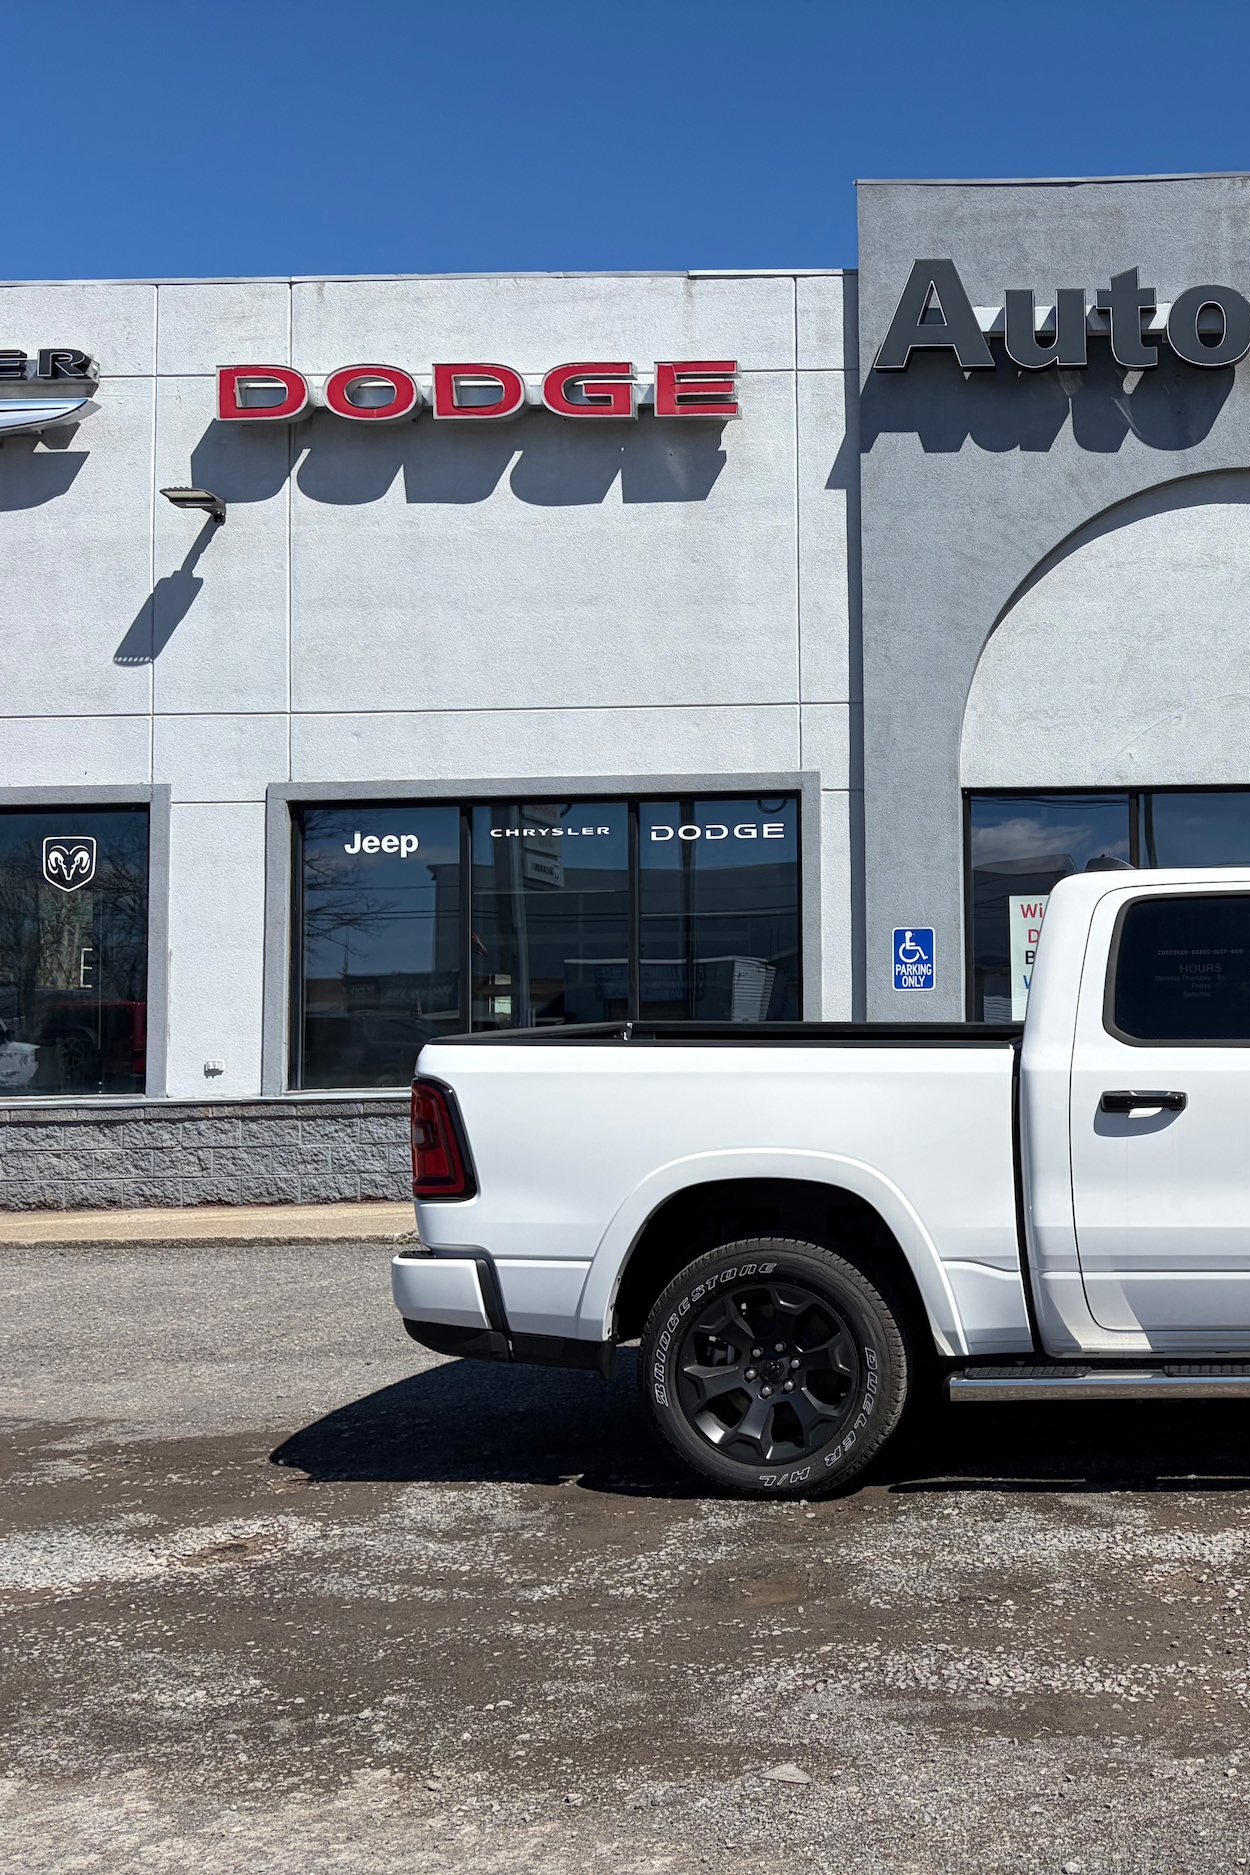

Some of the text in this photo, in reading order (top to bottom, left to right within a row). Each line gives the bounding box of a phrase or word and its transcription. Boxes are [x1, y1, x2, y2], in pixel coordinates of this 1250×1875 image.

[216, 361, 743, 422] DODGE
[489, 826, 611, 838] CHRYSLER
[650, 823, 785, 841] DODGE
[344, 830, 420, 858] Jeep
[895, 963, 933, 976] PARKING
[1180, 963, 1223, 974] HOURS
[901, 975, 926, 988] ONLY
[653, 1262, 778, 1408] BRIDGESTONE
[824, 1346, 878, 1467] DUELER
[758, 1465, 811, 1487] H/L
